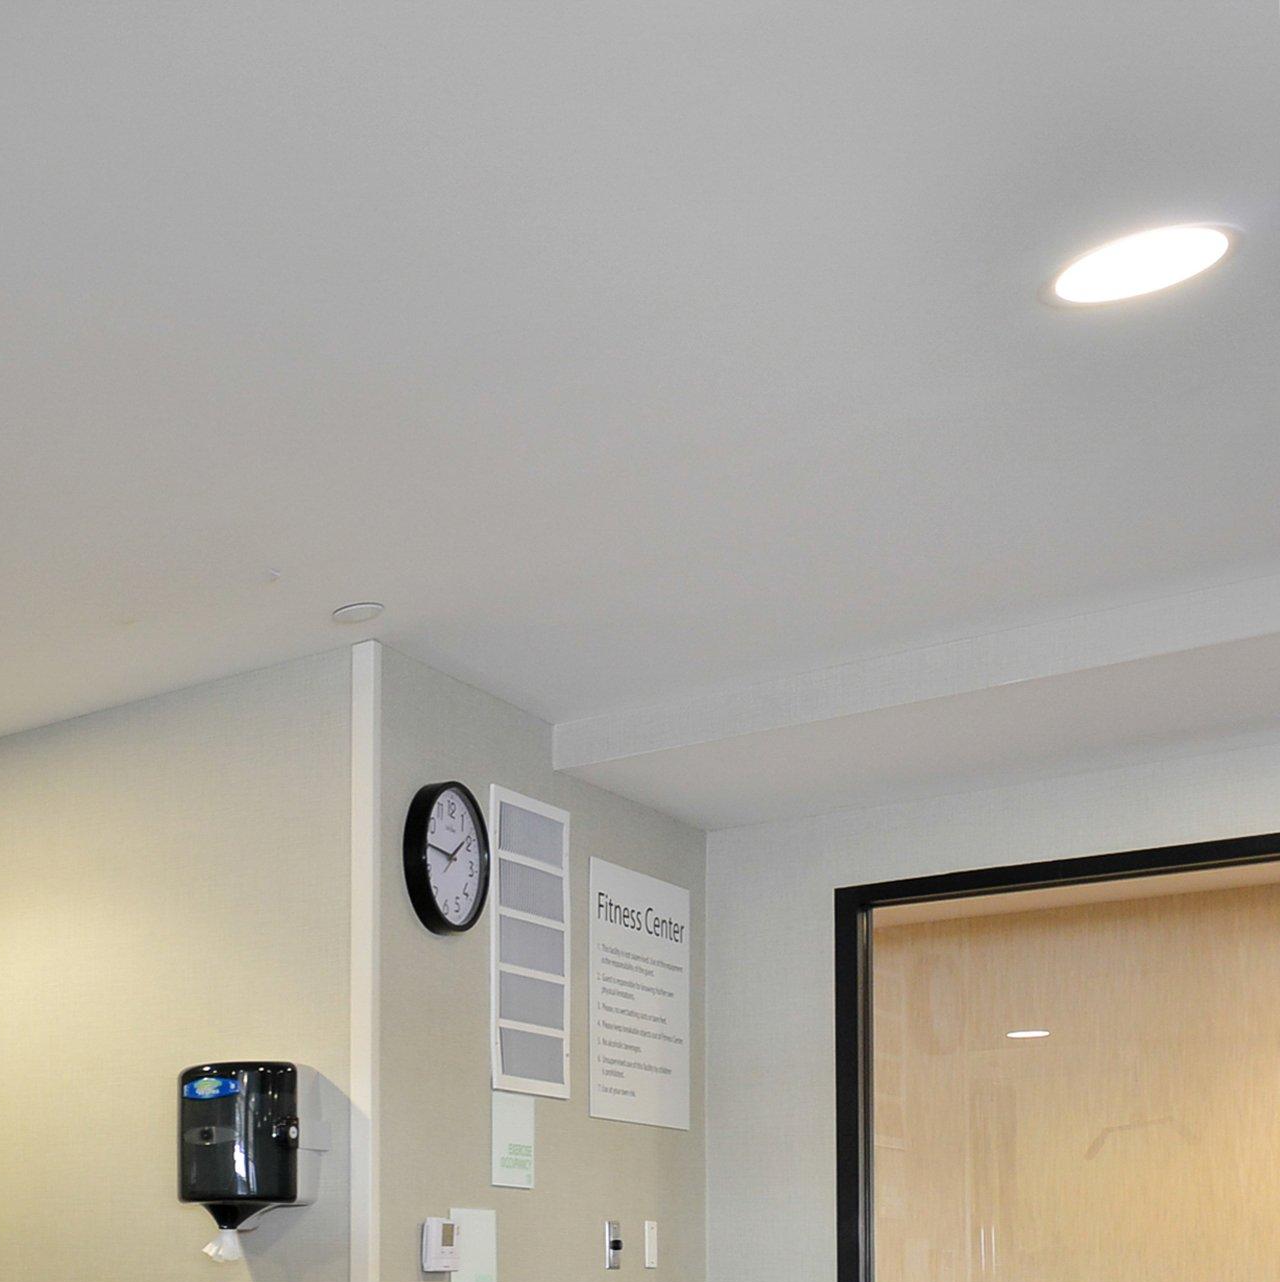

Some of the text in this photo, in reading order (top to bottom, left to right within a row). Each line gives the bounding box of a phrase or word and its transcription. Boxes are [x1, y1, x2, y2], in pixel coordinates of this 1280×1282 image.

[448, 800, 457, 819] 12
[465, 835, 472, 853] 2
[468, 861, 475, 878] 3
[443, 899, 449, 916] 6
[454, 896, 460, 913] 5
[597, 891, 684, 943] Fitness Center
